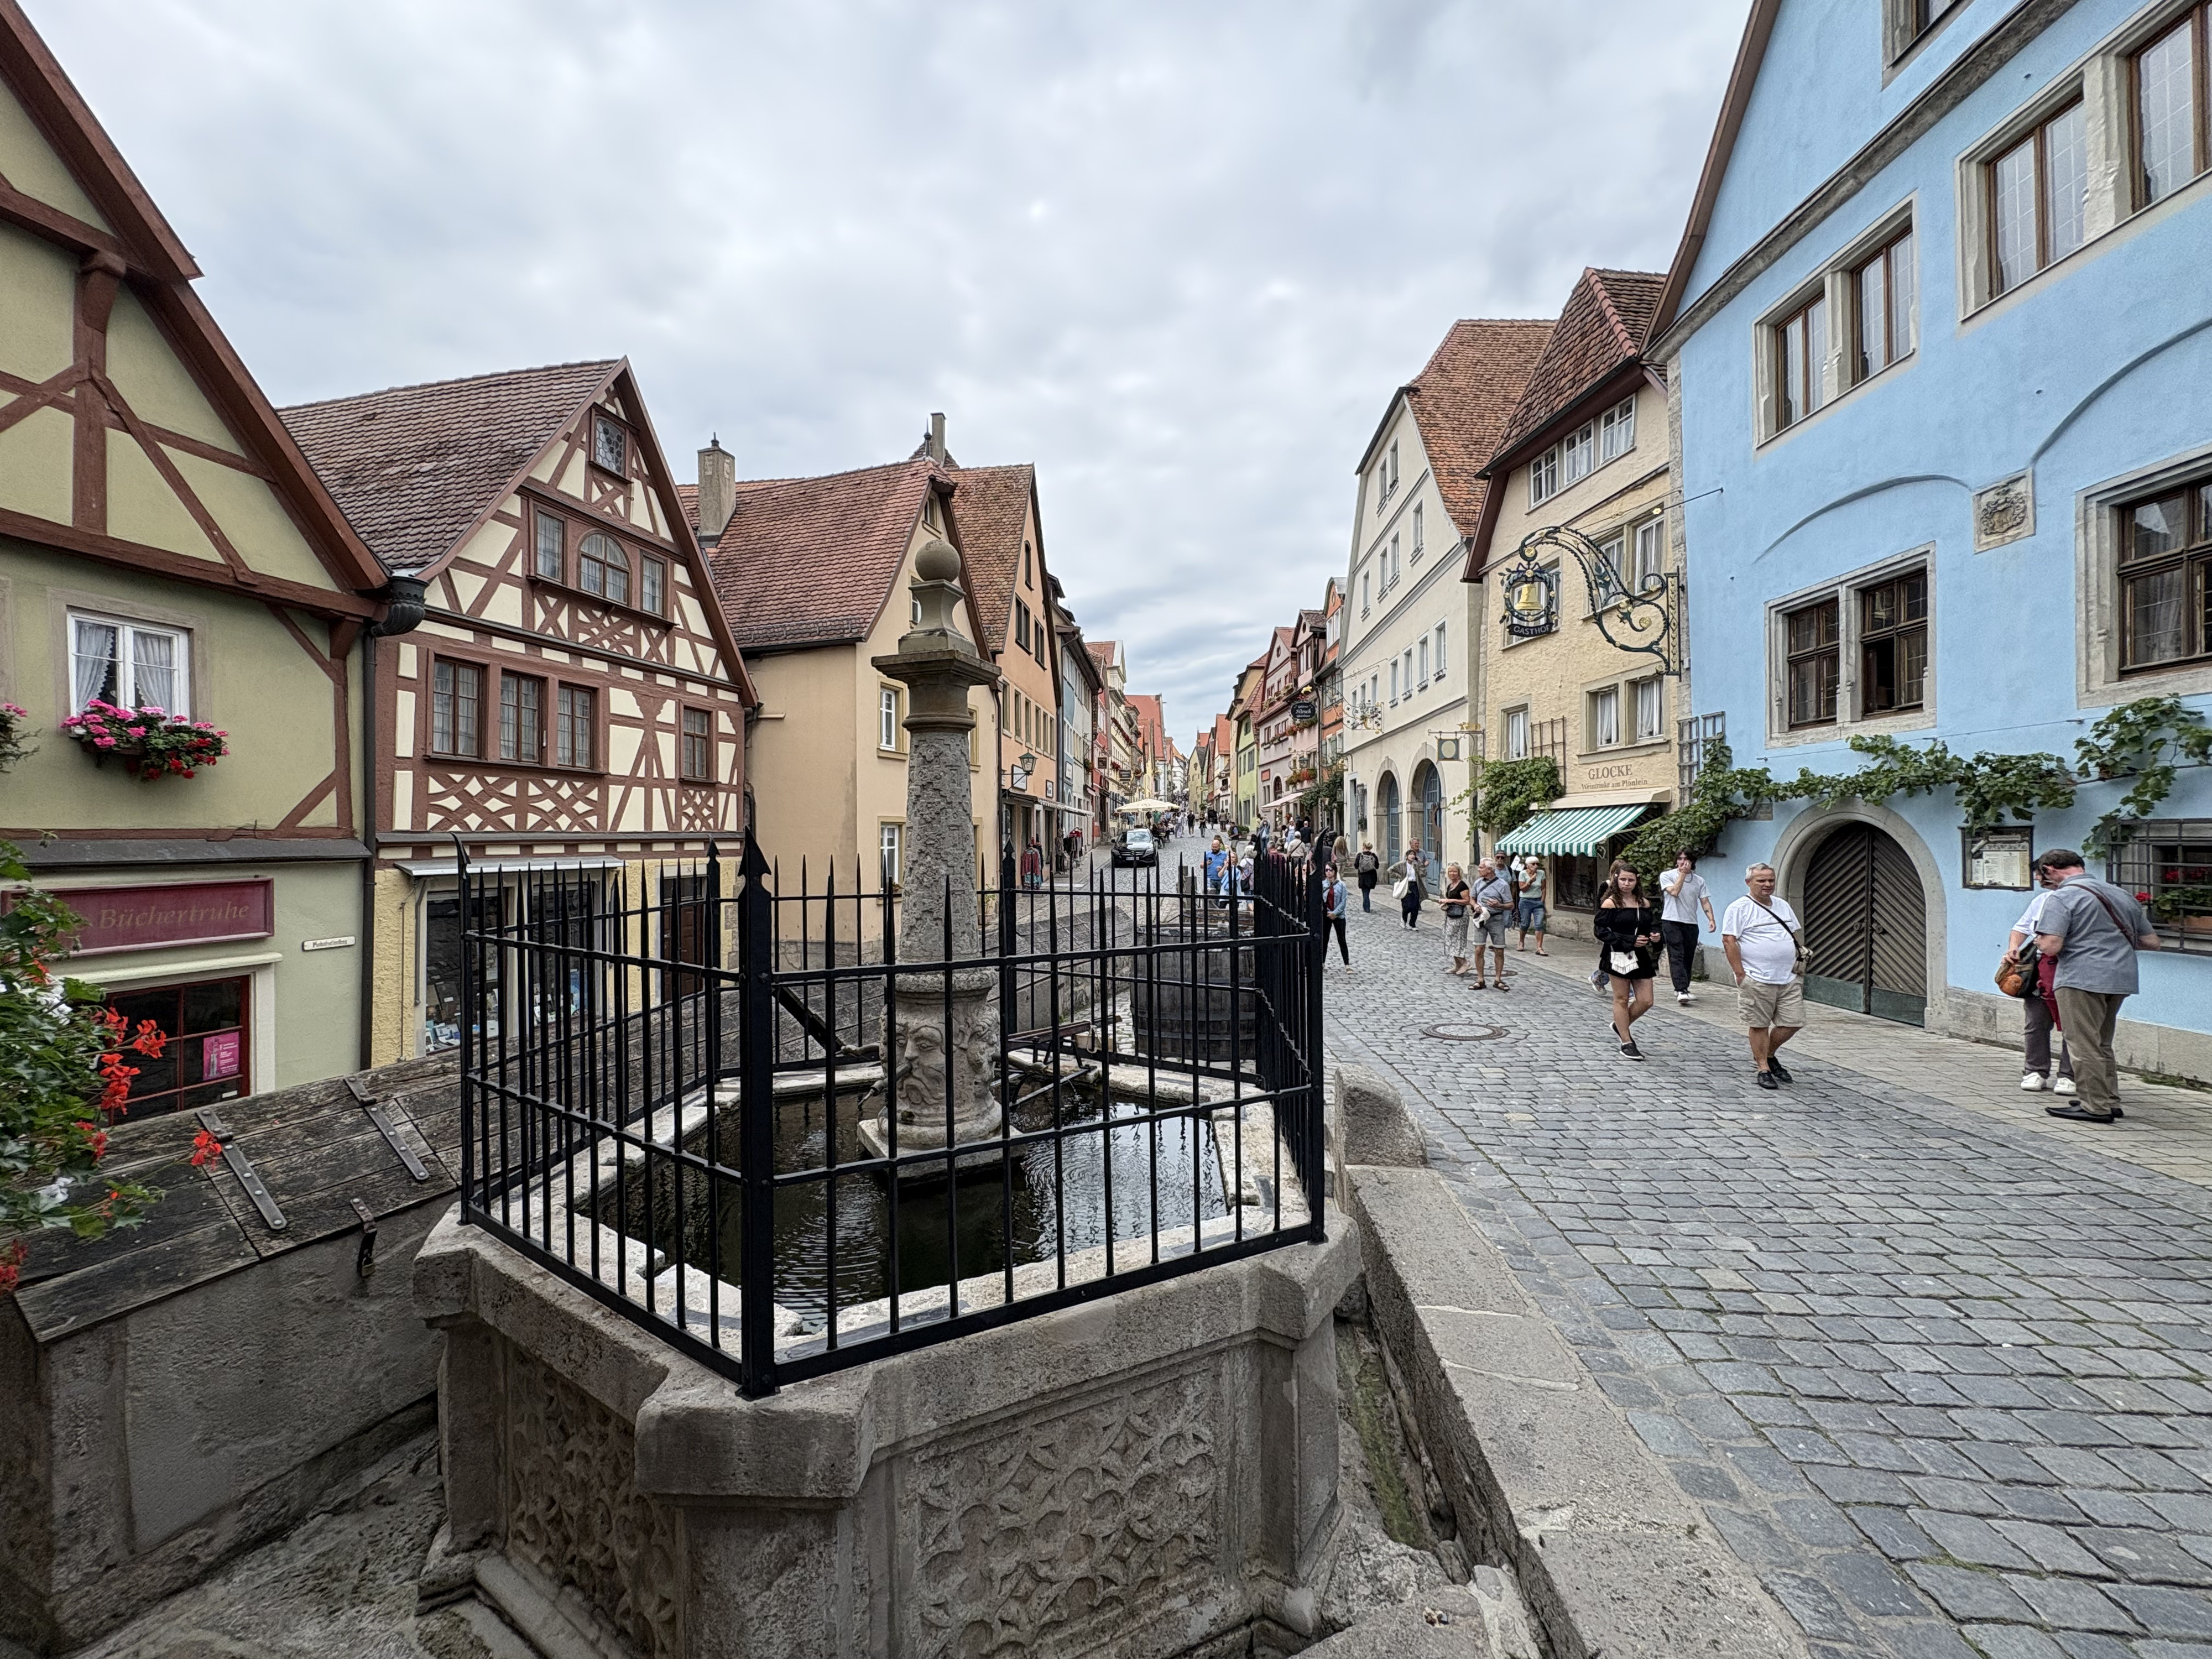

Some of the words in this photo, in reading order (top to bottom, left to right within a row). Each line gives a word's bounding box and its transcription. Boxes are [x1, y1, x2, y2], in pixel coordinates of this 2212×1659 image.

[1513, 624, 1550, 635] GASTHOF
[1588, 764, 1632, 780] GLOCKE
[100, 901, 249, 929] Büchertruhe
